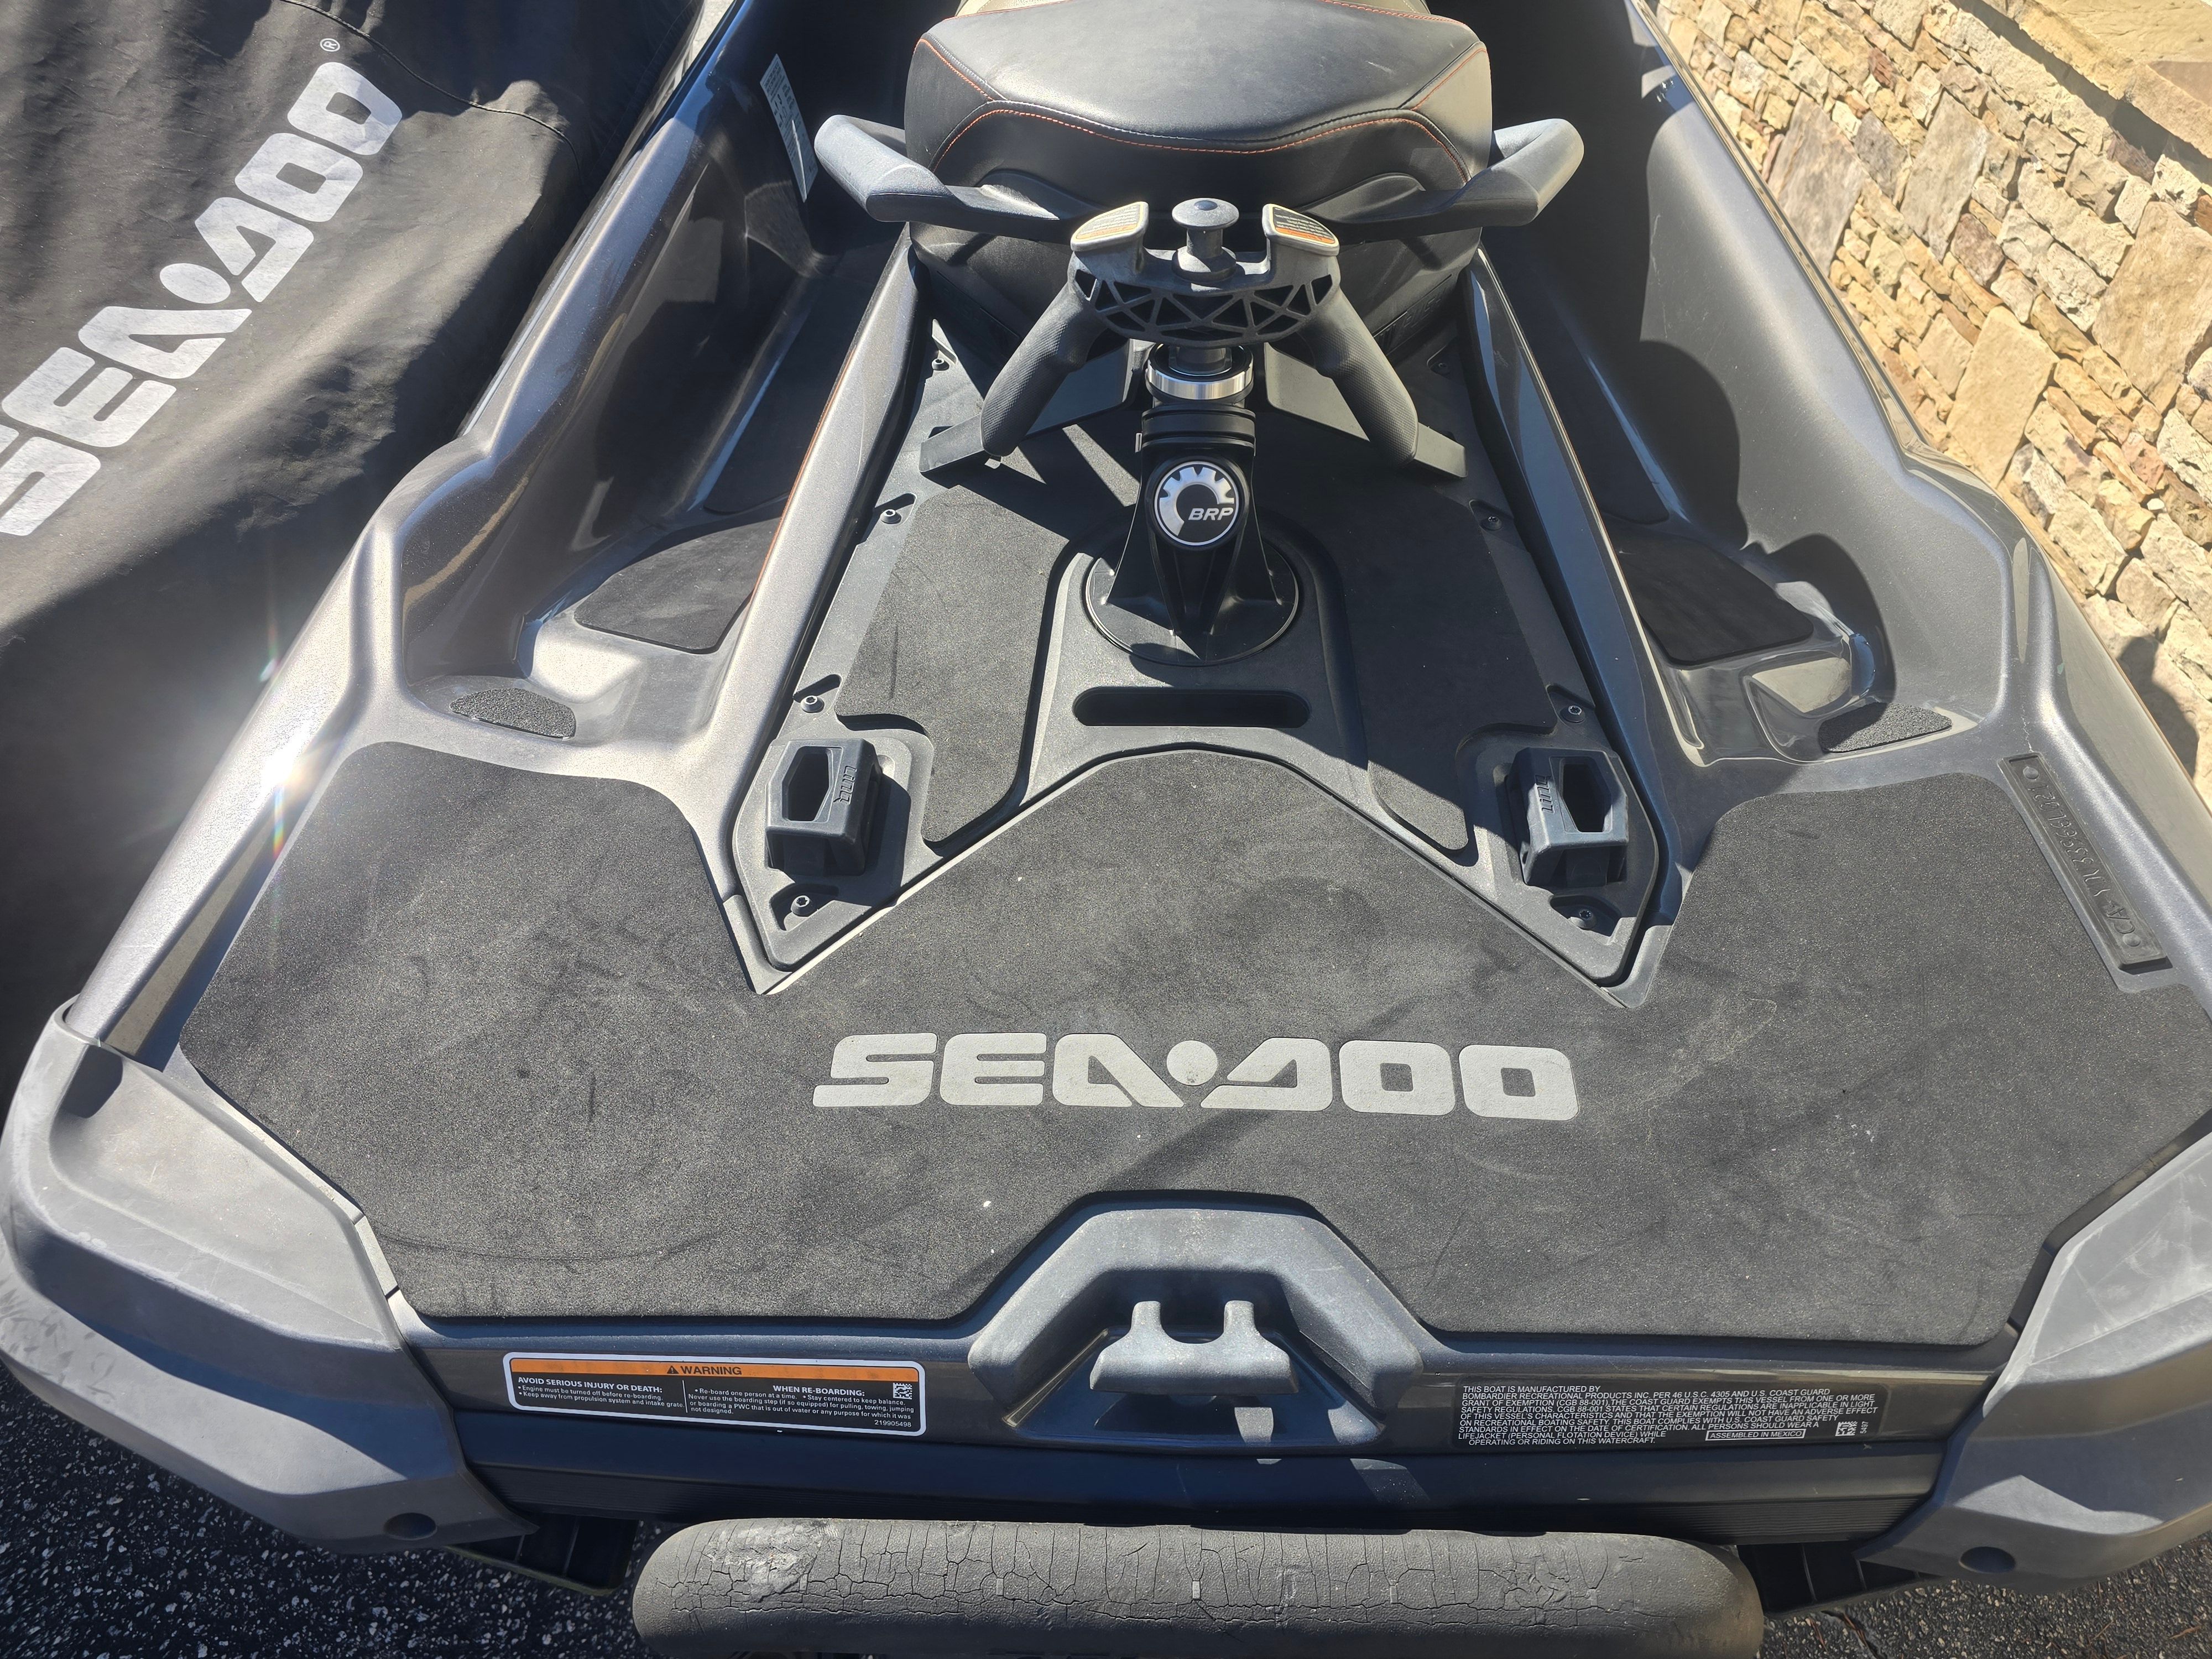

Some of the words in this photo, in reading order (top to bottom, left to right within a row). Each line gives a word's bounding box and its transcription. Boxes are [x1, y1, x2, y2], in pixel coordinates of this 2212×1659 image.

[1188, 507, 1234, 521] BRP
[681, 1366, 742, 1375] WARNING
[584, 1381, 614, 1390] INJURY
[734, 1396, 763, 1405] boarding
